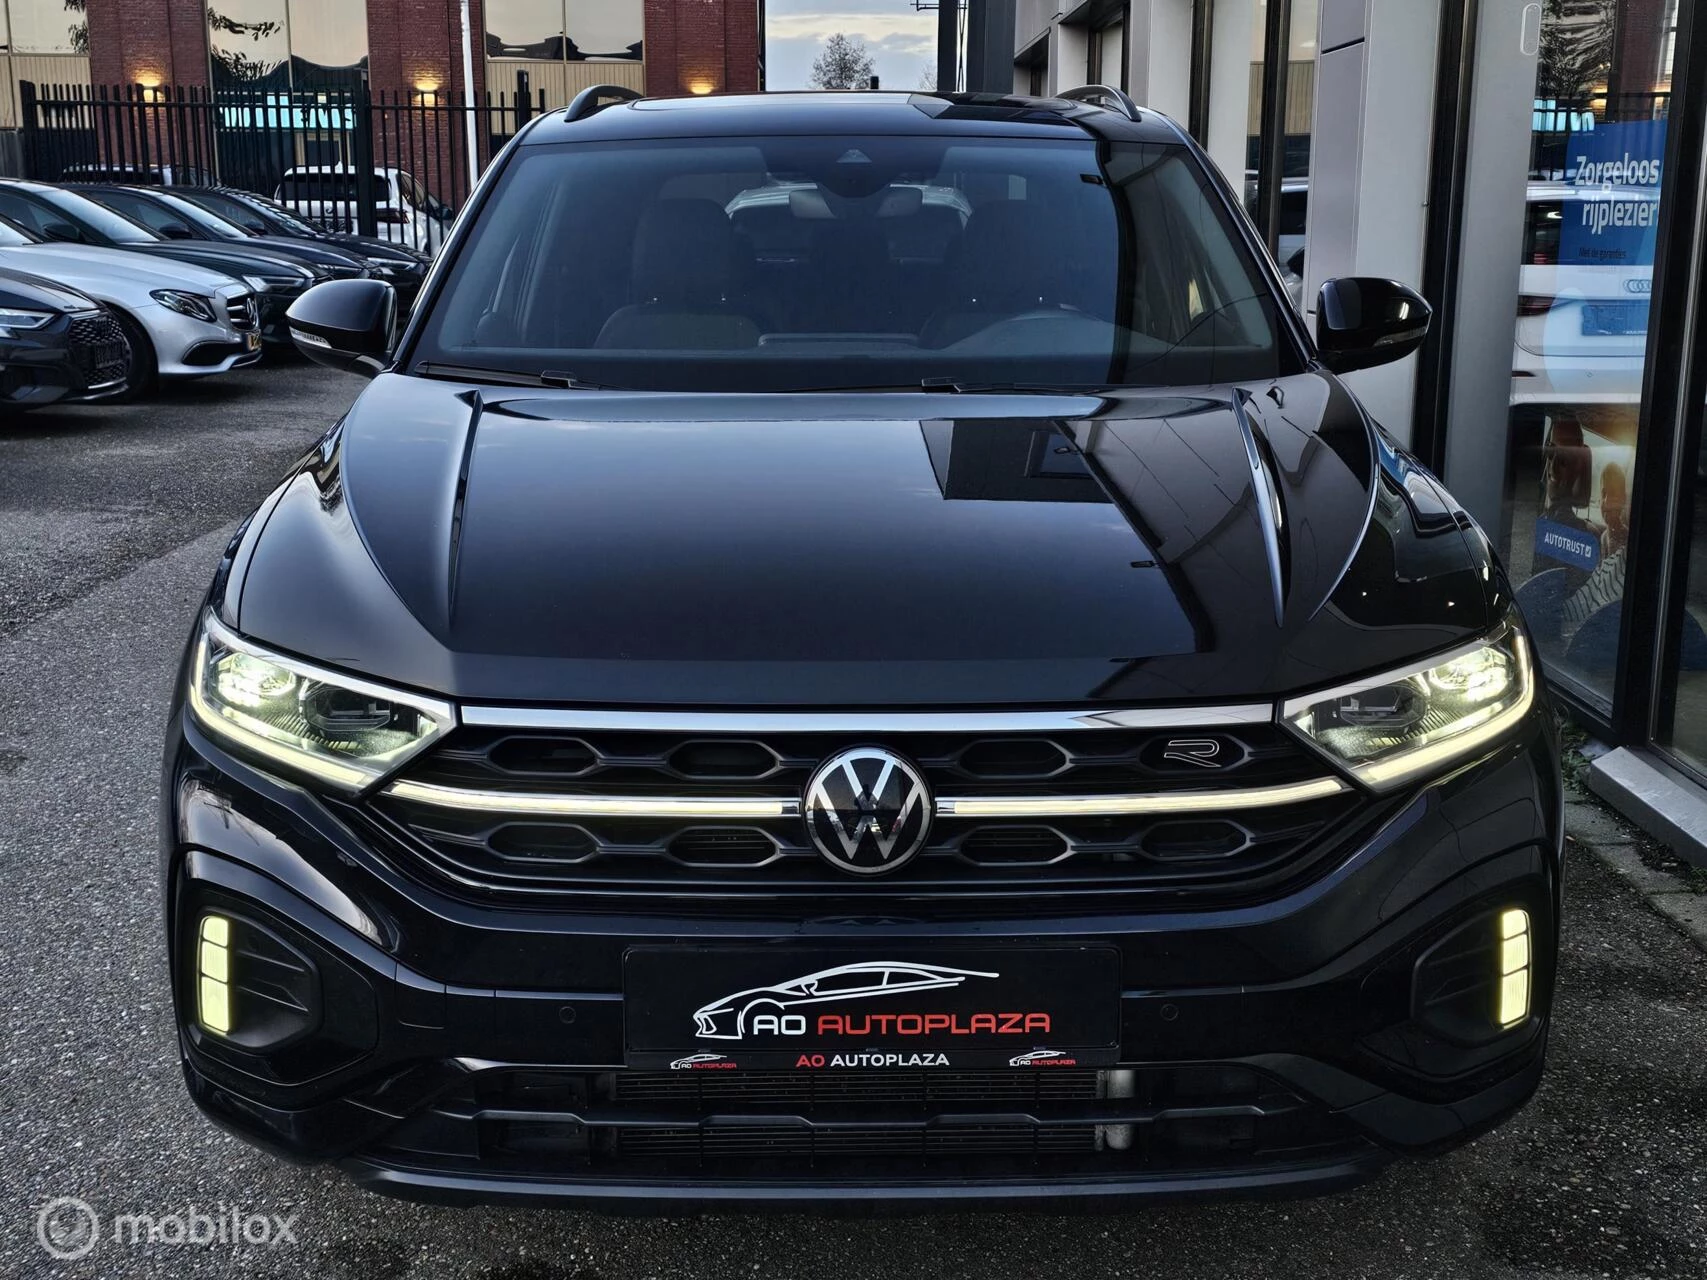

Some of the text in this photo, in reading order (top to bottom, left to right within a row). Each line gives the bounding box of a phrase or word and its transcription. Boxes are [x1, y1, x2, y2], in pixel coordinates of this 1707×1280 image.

[1575, 153, 1660, 193] Zorgeloos
[1582, 195, 1658, 234] rijplezier
[1544, 532, 1585, 555] AUTOTRUST
[753, 1012, 1051, 1035] AO AUTOPLAZA
[796, 1053, 950, 1068] AO AUTOPLAZA
